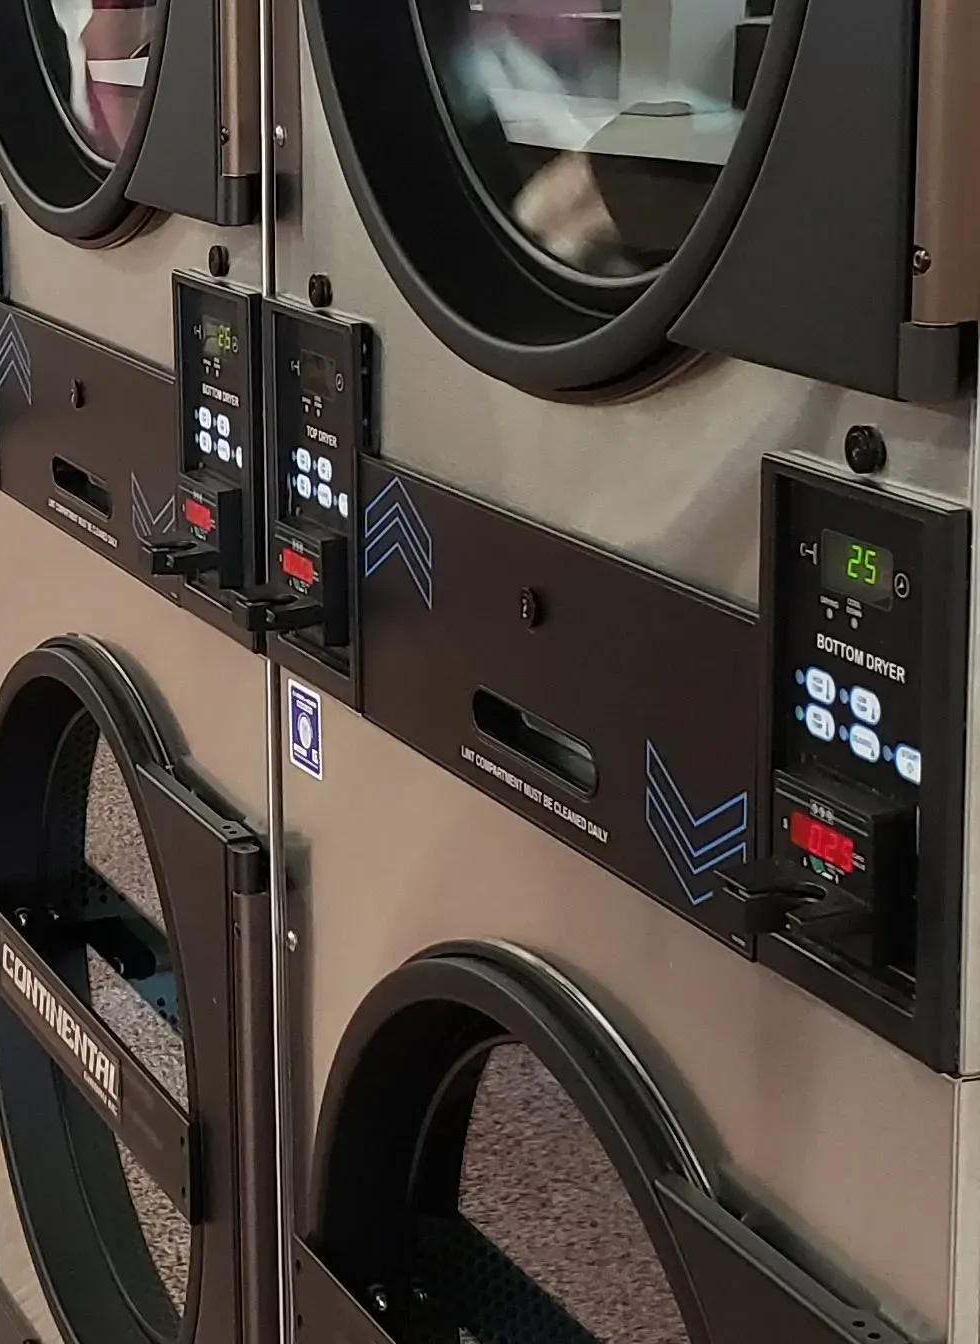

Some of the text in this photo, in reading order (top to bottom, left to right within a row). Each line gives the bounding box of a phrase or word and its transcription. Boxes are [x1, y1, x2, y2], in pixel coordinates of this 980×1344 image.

[306, 425, 318, 440] TOP
[847, 544, 877, 585] 25
[816, 632, 906, 684] BOTTOM DRYER
[461, 744, 609, 844] LINT COMPARTMENT MUST BE CLEANED DAILY
[2, 942, 119, 1101] CONTINENTAL
